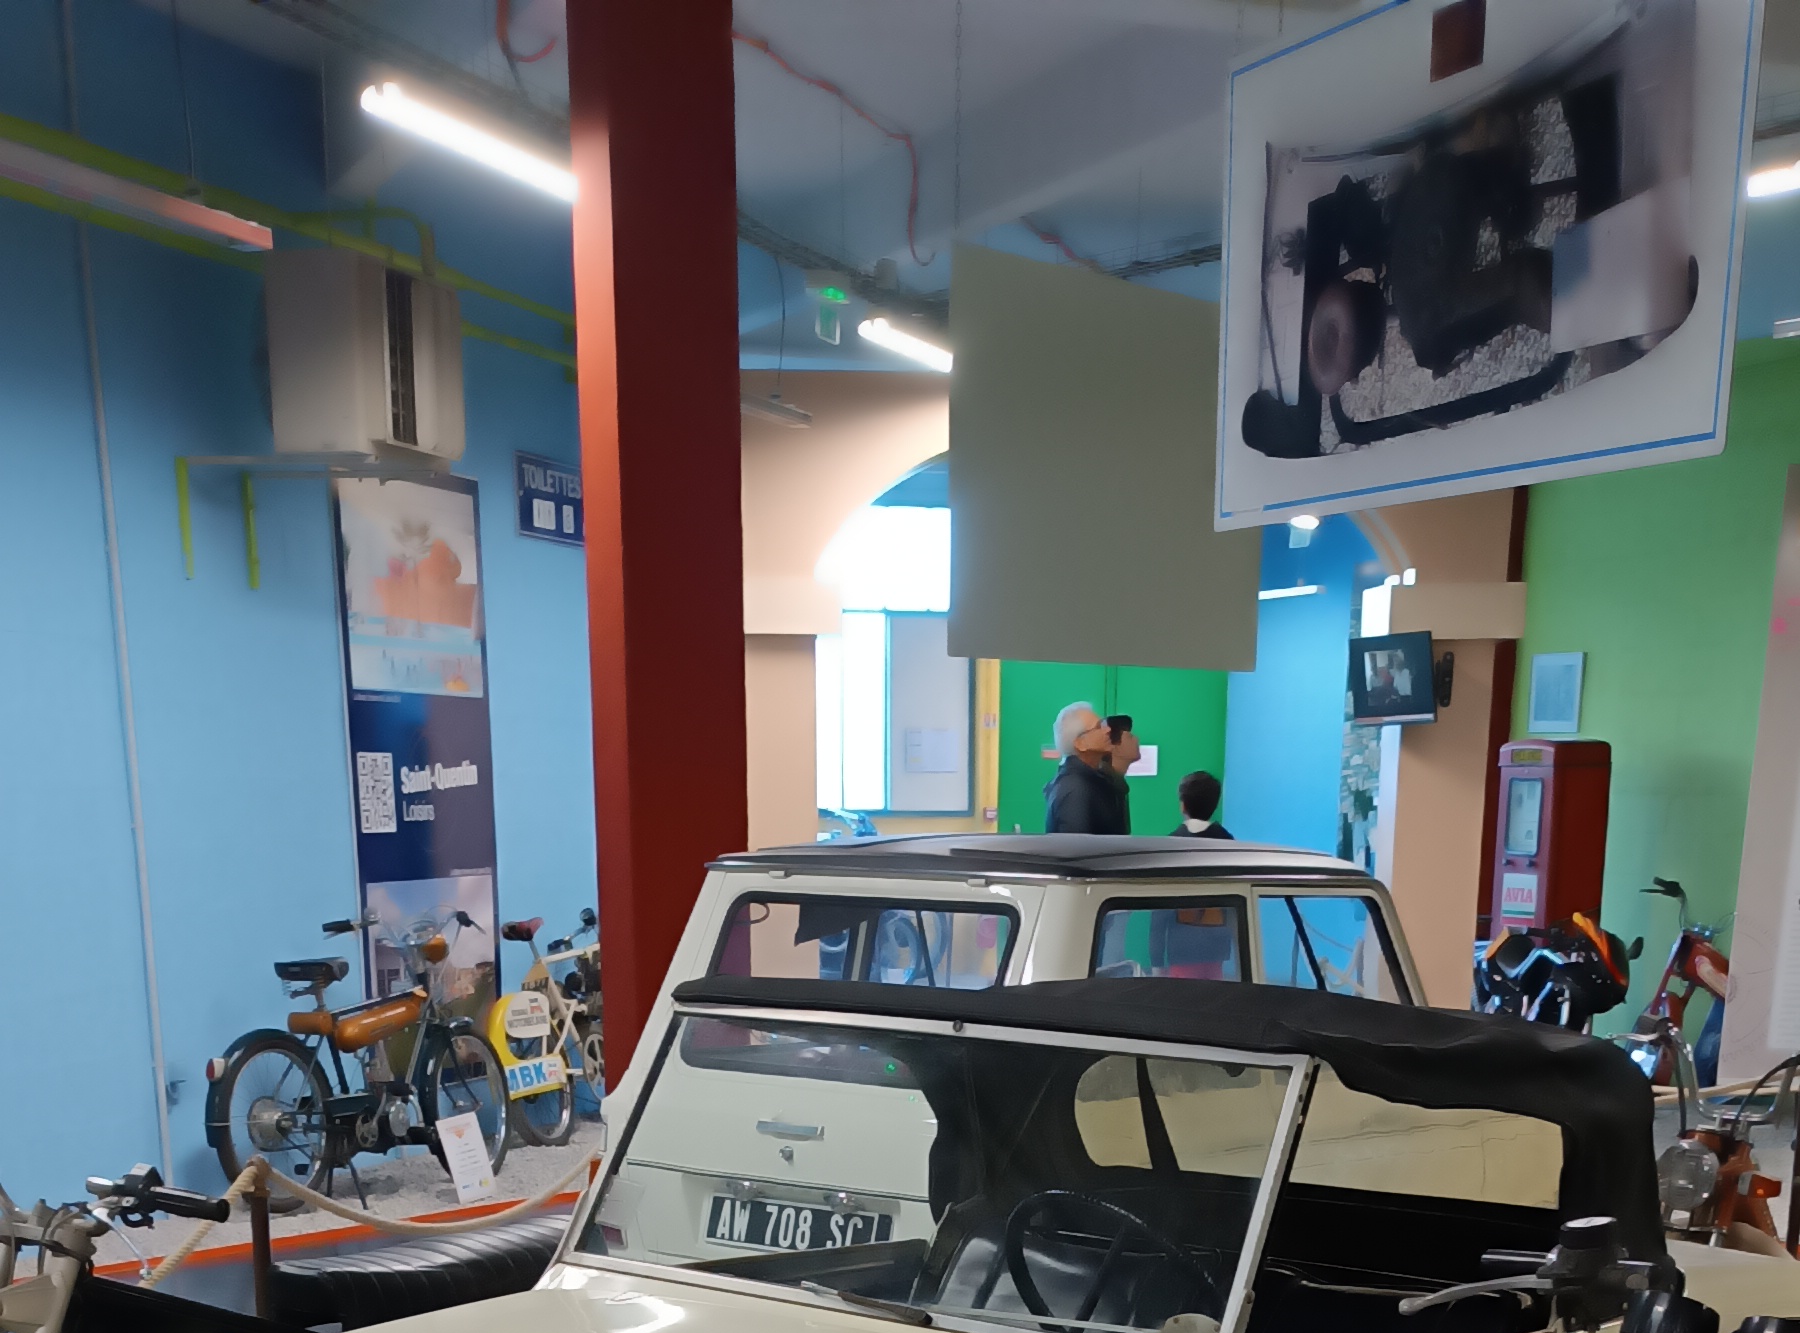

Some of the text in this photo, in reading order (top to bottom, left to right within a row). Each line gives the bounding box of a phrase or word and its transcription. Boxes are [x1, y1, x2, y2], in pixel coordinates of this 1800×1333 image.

[522, 463, 581, 499] TOILETTES
[401, 760, 478, 794] Saint-Quentin
[403, 801, 435, 821] Loisirs
[1504, 887, 1533, 904] AVIA
[716, 1199, 751, 1242] AW
[764, 1205, 813, 1250] 708
